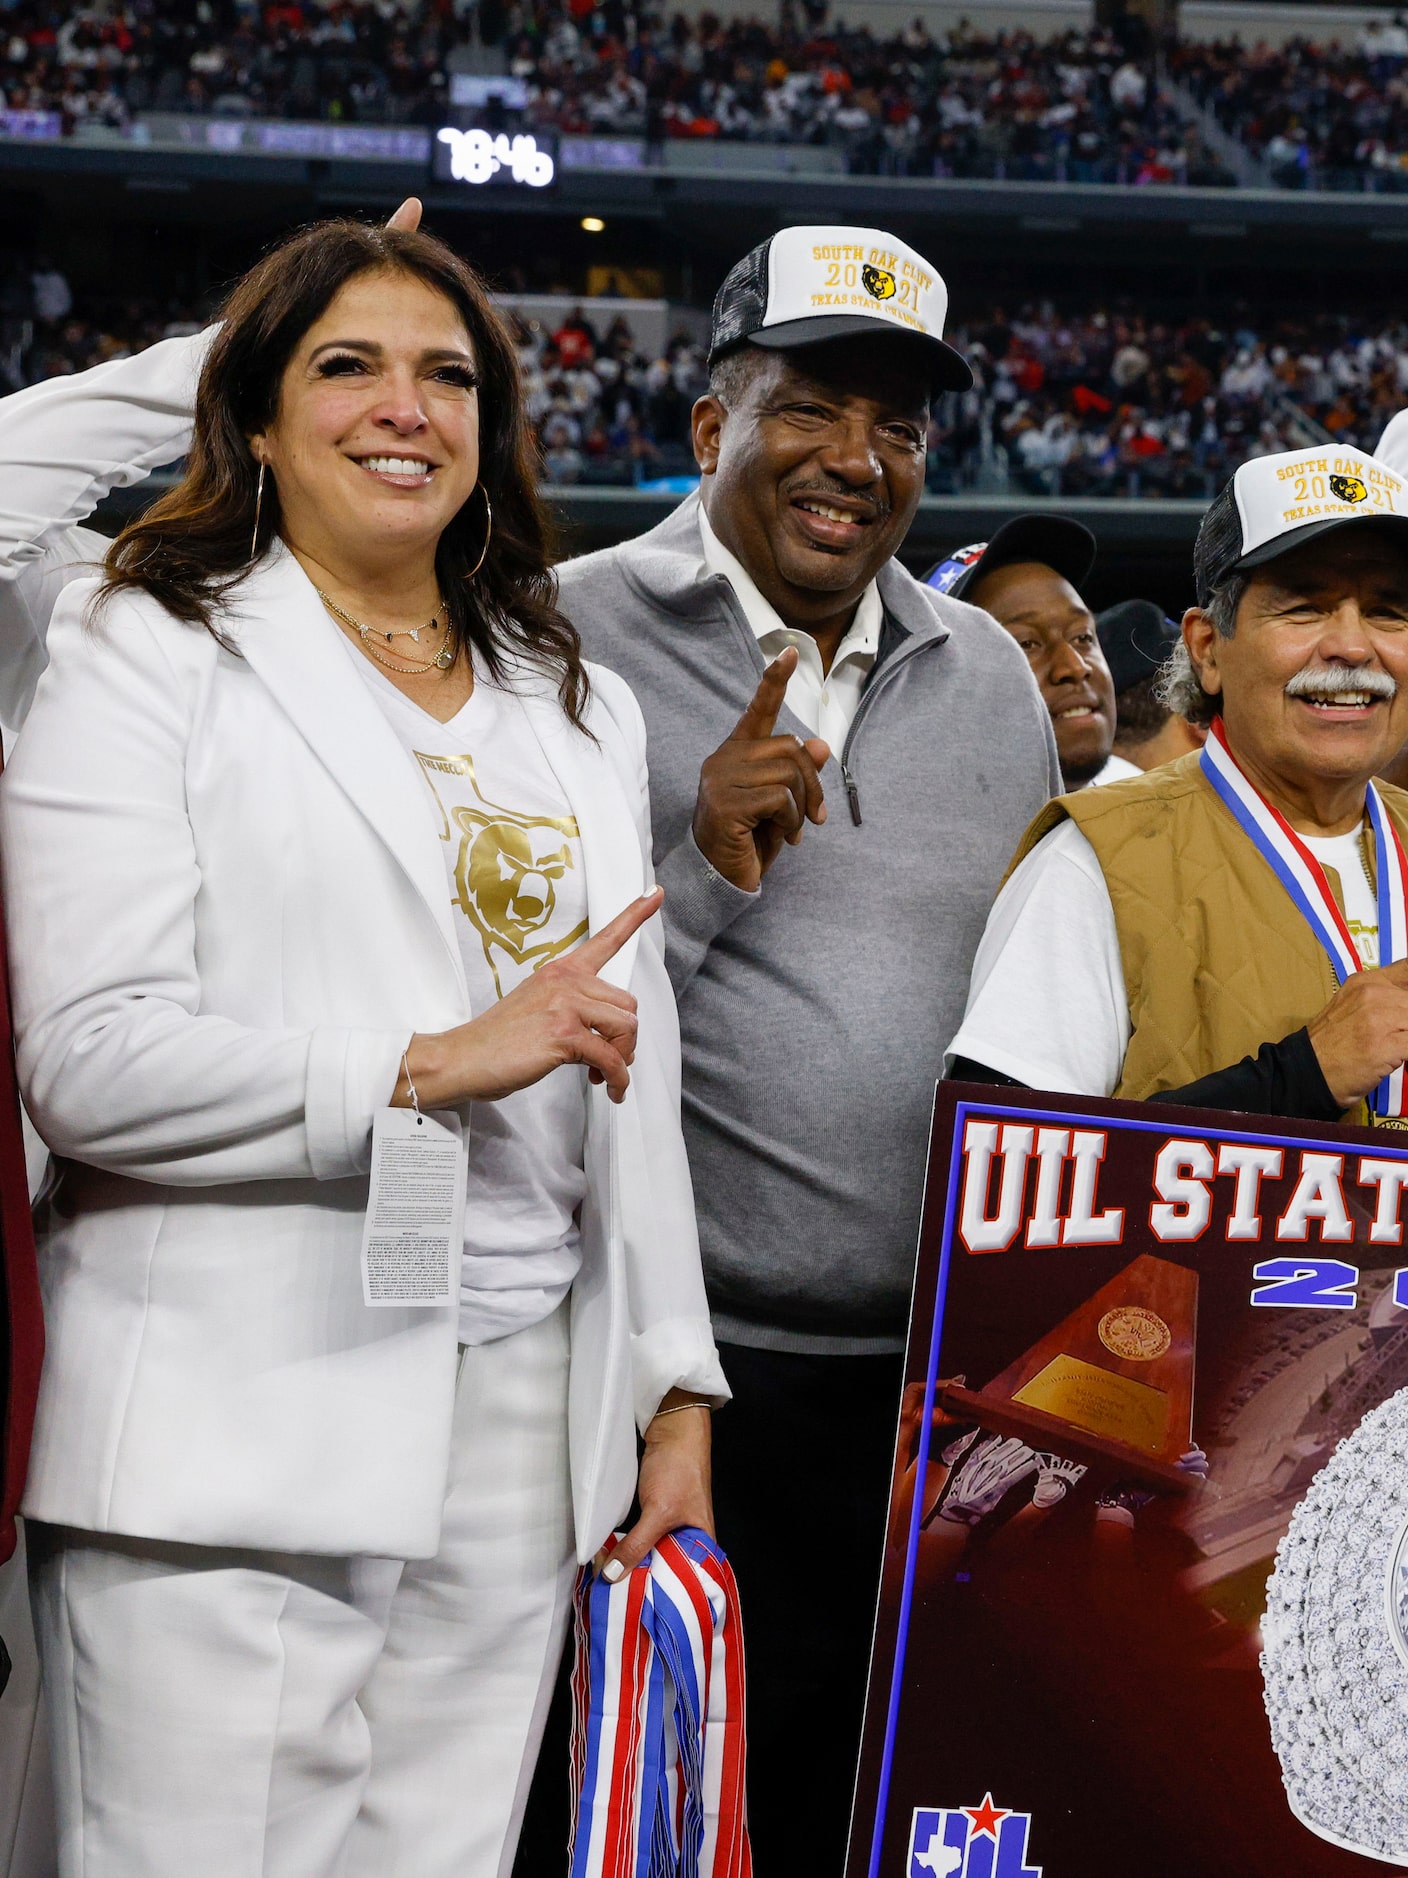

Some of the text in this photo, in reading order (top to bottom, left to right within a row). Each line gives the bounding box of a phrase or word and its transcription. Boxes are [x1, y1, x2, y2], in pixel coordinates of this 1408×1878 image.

[812, 245, 933, 292] SOUTH OAK CLIFF
[825, 263, 919, 313] 20 21
[811, 294, 848, 306] TEXAS
[851, 295, 882, 310] STATE
[1276, 458, 1401, 493] SOUTH OAK CLIFF
[1294, 476, 1396, 513] 20 21
[1283, 505, 1321, 522] TEXAS
[1324, 504, 1358, 513] STATE
[959, 1120, 1125, 1253] UIL
[906, 1806, 1043, 1878] UIL
